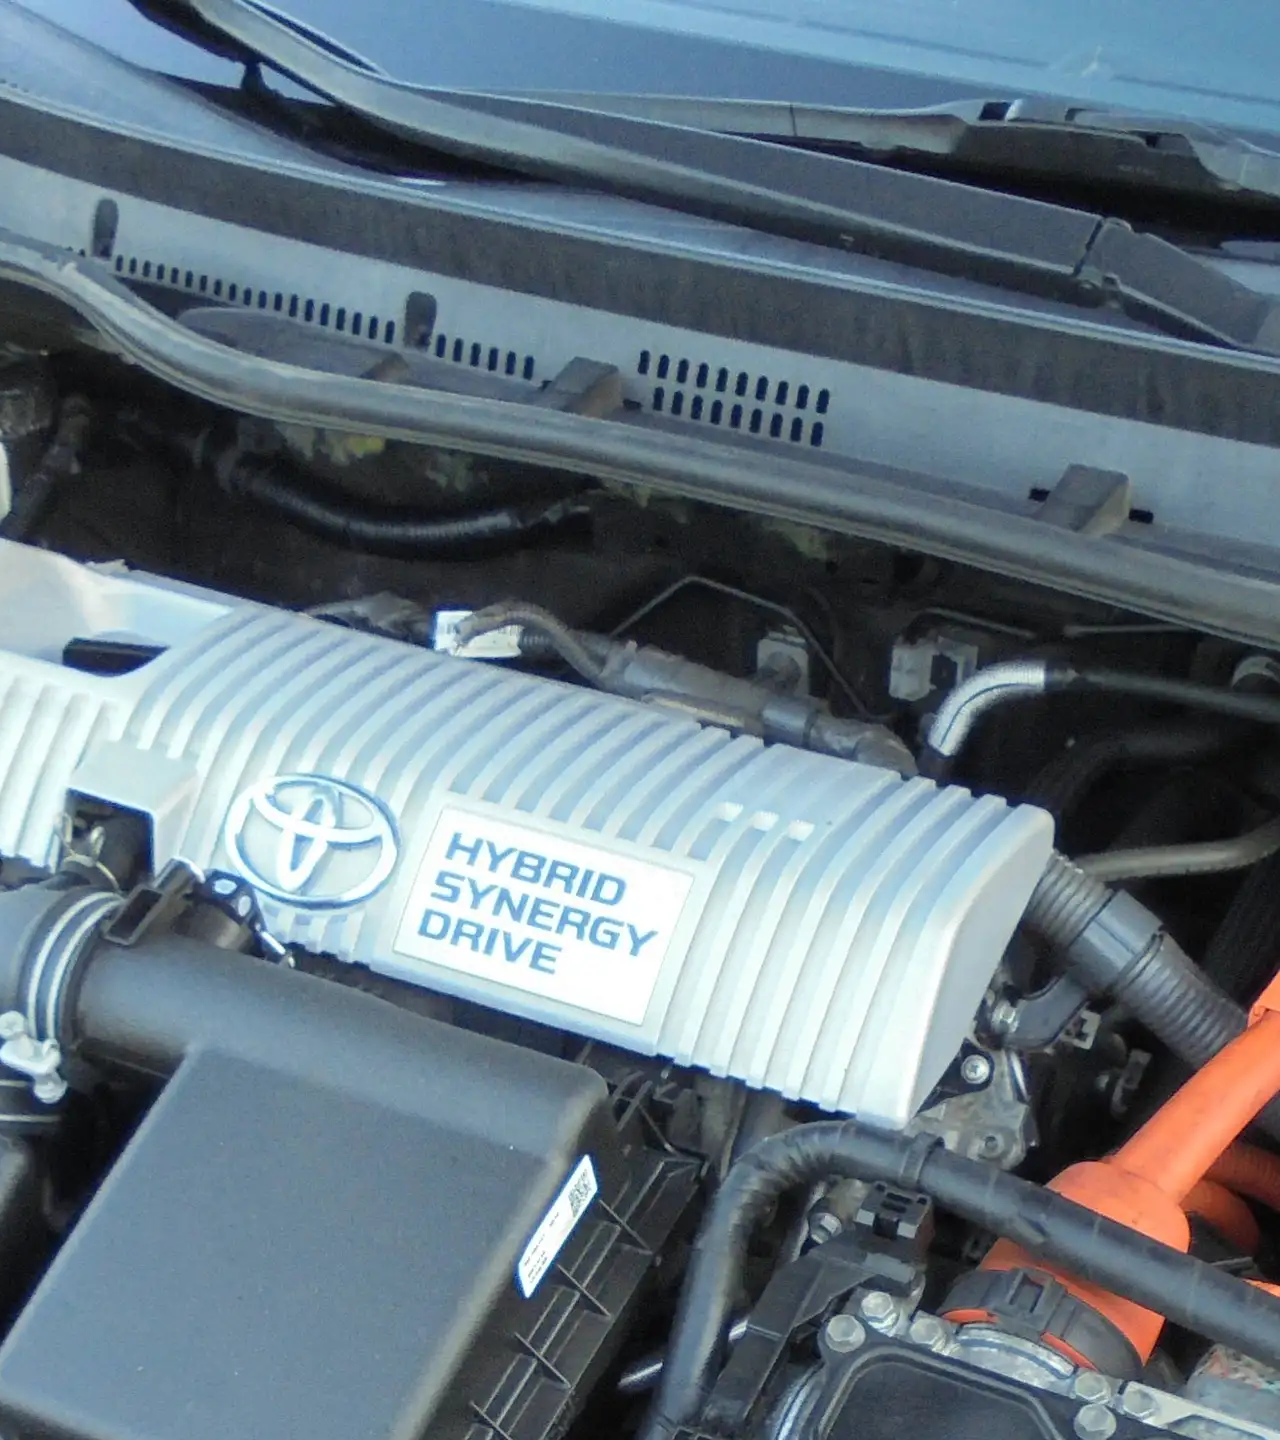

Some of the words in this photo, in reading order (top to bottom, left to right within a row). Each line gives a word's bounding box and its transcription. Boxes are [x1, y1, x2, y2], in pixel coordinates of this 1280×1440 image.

[445, 832, 627, 906] HYBRID
[417, 908, 562, 974] DRIVE
[430, 870, 658, 957] SYNERGY
